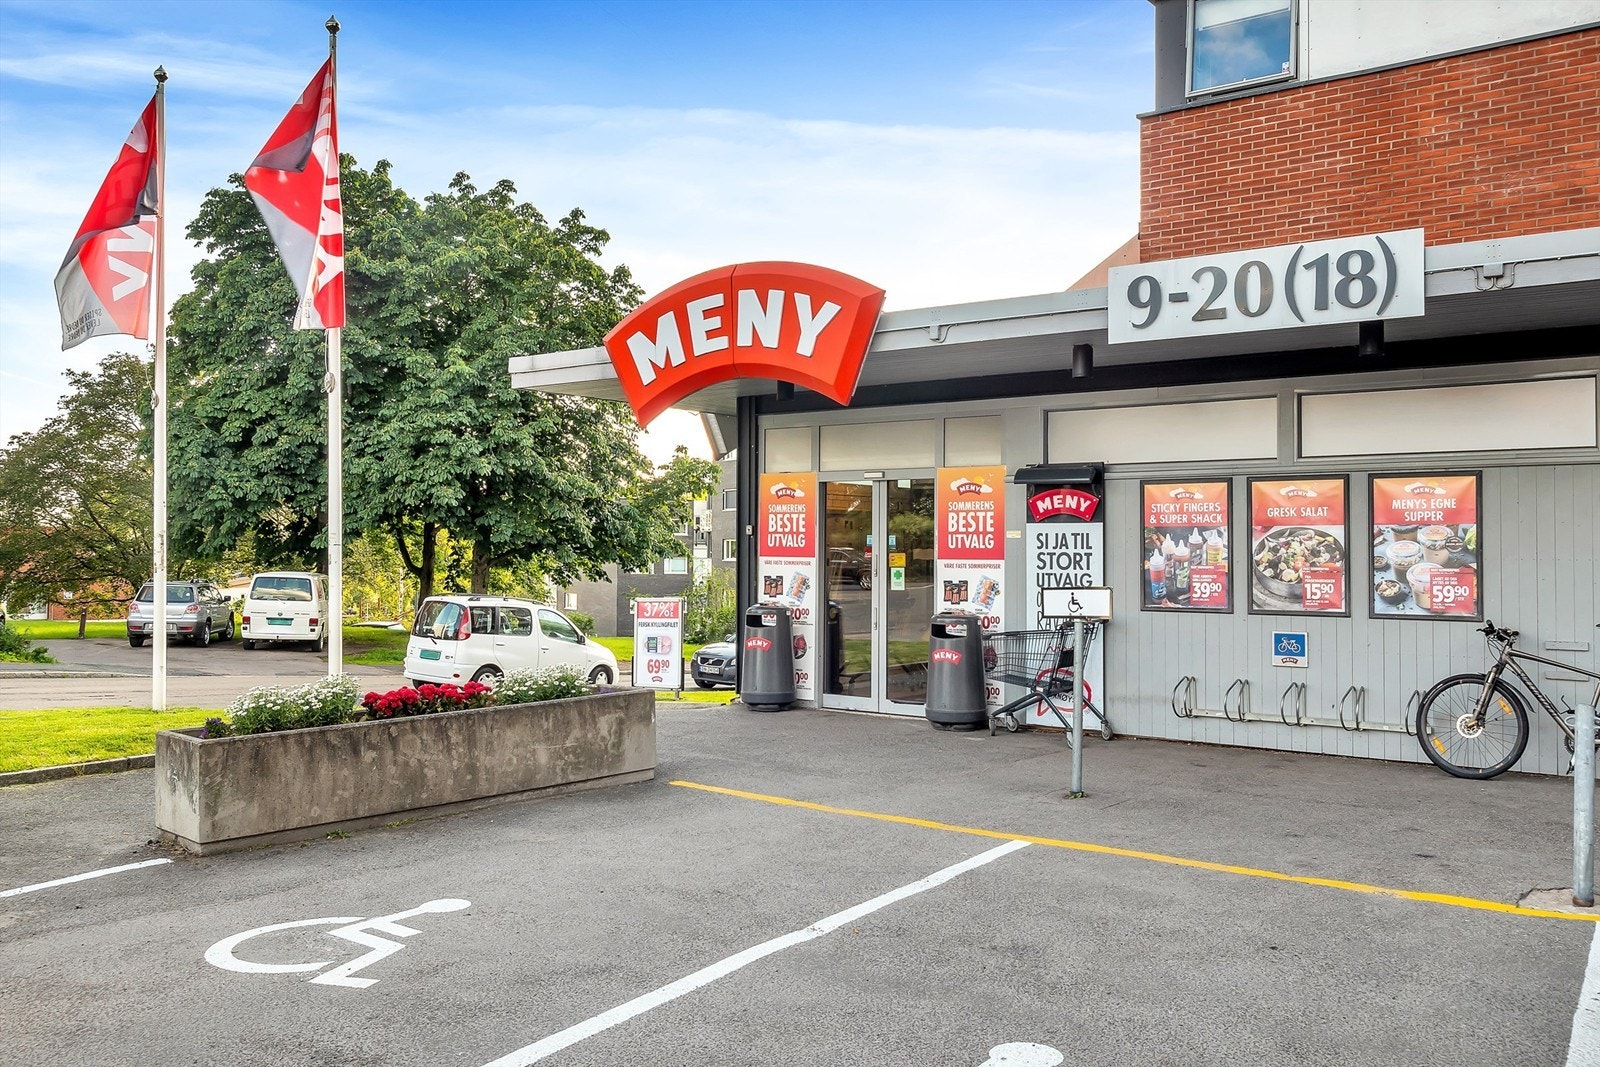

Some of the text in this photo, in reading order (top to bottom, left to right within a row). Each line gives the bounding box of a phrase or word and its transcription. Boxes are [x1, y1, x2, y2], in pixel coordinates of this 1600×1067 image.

[1127, 235, 1397, 330] 9-20(18)
[626, 288, 842, 386] MENY
[776, 488, 795, 497] MENY
[959, 484, 981, 493] MENY
[768, 503, 807, 513] SOMMERENS
[948, 501, 995, 511] SOMMERENS
[1036, 494, 1091, 514] MENY
[1151, 502, 1221, 513] STICKY FINGERS
[1392, 498, 1457, 509] MENYS EGNE
[1267, 506, 1329, 517] GRESK SALAT
[1404, 511, 1444, 521] SUPPER
[768, 513, 807, 533] BESTE
[948, 511, 995, 533] BESTE
[1149, 513, 1223, 524] & SUPER SHACK
[767, 533, 806, 548] UTVALG
[948, 533, 995, 549] UTVALG
[1036, 532, 1093, 550] SI JA TIL
[1036, 552, 1093, 571] STORT
[643, 602, 670, 617] 37%
[747, 639, 769, 649] MENY
[934, 652, 959, 661] MENY
